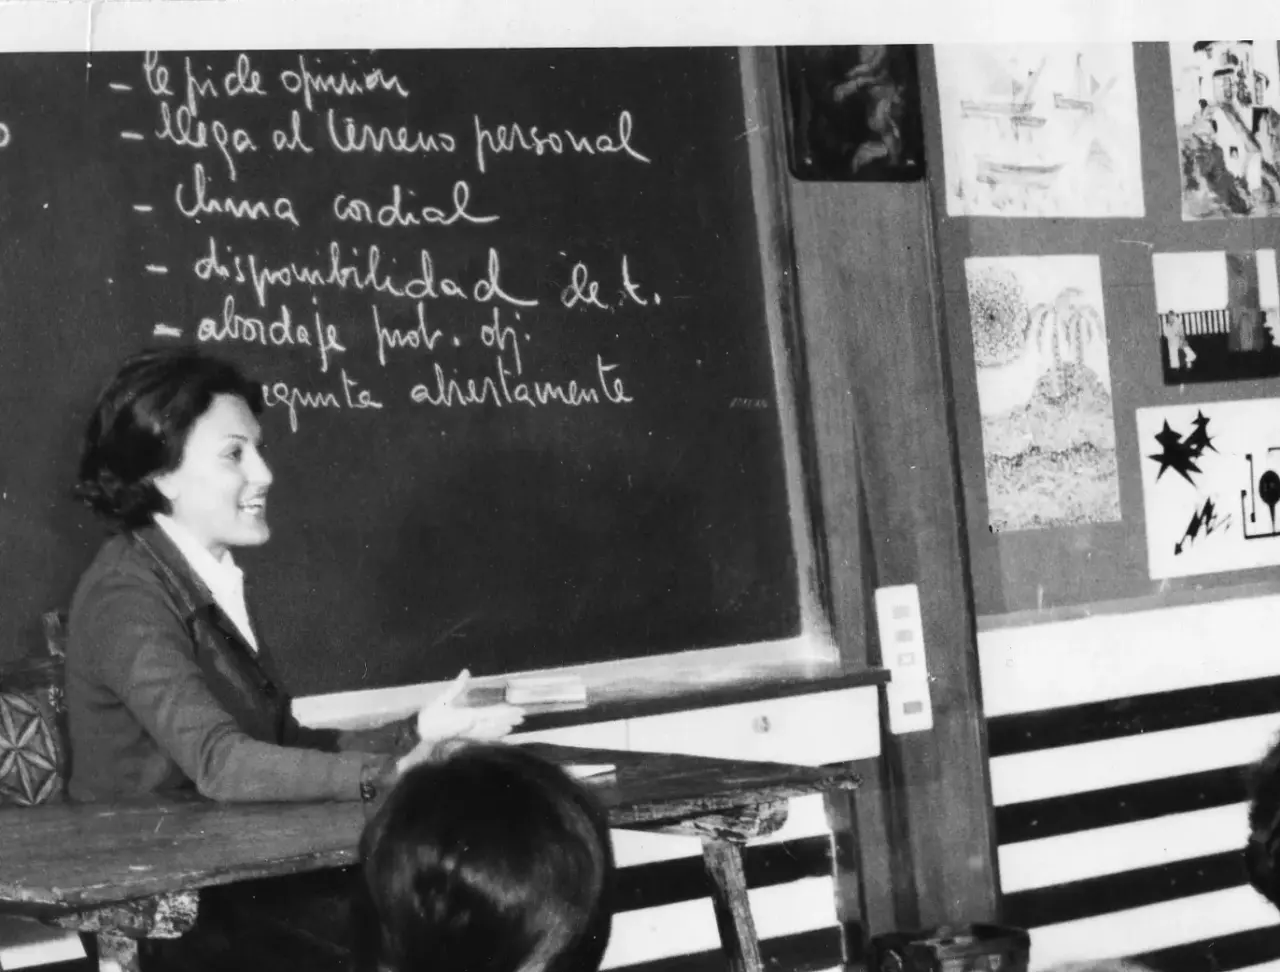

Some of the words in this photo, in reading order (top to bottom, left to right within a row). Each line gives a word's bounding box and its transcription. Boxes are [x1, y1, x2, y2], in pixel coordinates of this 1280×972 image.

[143, 49, 174, 95] le
[185, 53, 267, 118] pide
[154, 101, 257, 182] llega
[272, 109, 314, 153] al
[327, 108, 456, 153] terreno
[474, 110, 651, 173] personal
[334, 181, 500, 227] cordial
[194, 236, 540, 308] disponibilidad
[561, 263, 609, 309] de
[197, 293, 346, 374] abordaje
[410, 354, 634, 408] abiertamente
